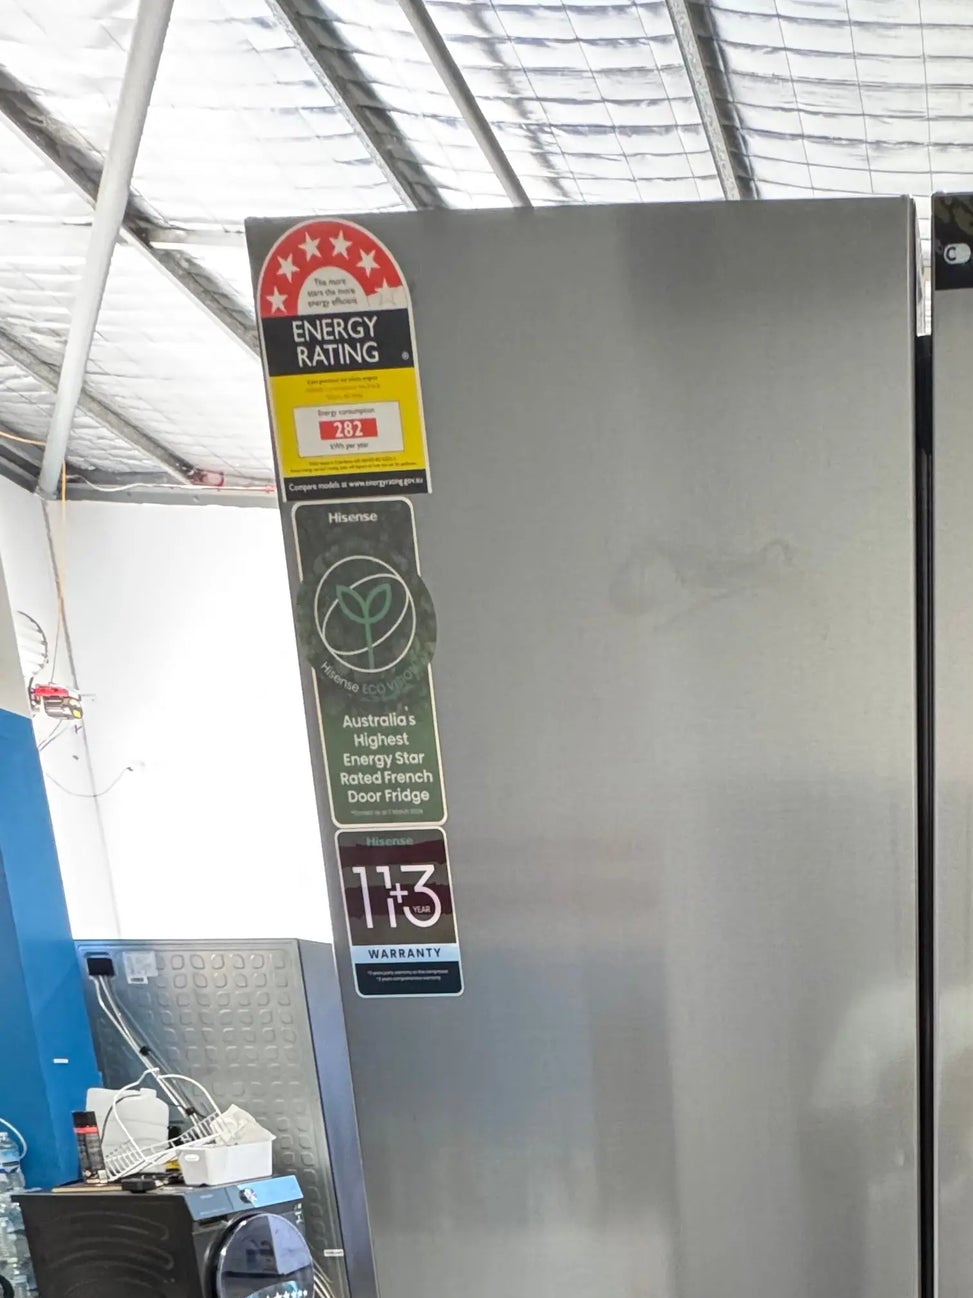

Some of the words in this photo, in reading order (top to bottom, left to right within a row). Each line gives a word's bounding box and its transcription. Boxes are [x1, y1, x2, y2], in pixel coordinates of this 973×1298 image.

[291, 315, 378, 342] ENERGY
[296, 341, 380, 368] RATING
[317, 409, 337, 418] Energy
[338, 407, 375, 416] consumption
[333, 420, 363, 438] 282
[346, 443, 355, 451] per
[288, 482, 317, 493] Compare
[318, 481, 340, 489] models
[328, 511, 378, 524] Hisense
[320, 660, 360, 693] Hisense
[342, 705, 416, 729] Australia's
[353, 732, 409, 750] Highest
[343, 753, 392, 768] Energy
[395, 751, 425, 765] Star
[340, 771, 382, 785] Rated
[384, 769, 433, 784] French
[347, 790, 382, 803] Door
[384, 787, 430, 804] Fridge
[366, 836, 414, 846] Hisense
[368, 948, 442, 959] WARRANTY
